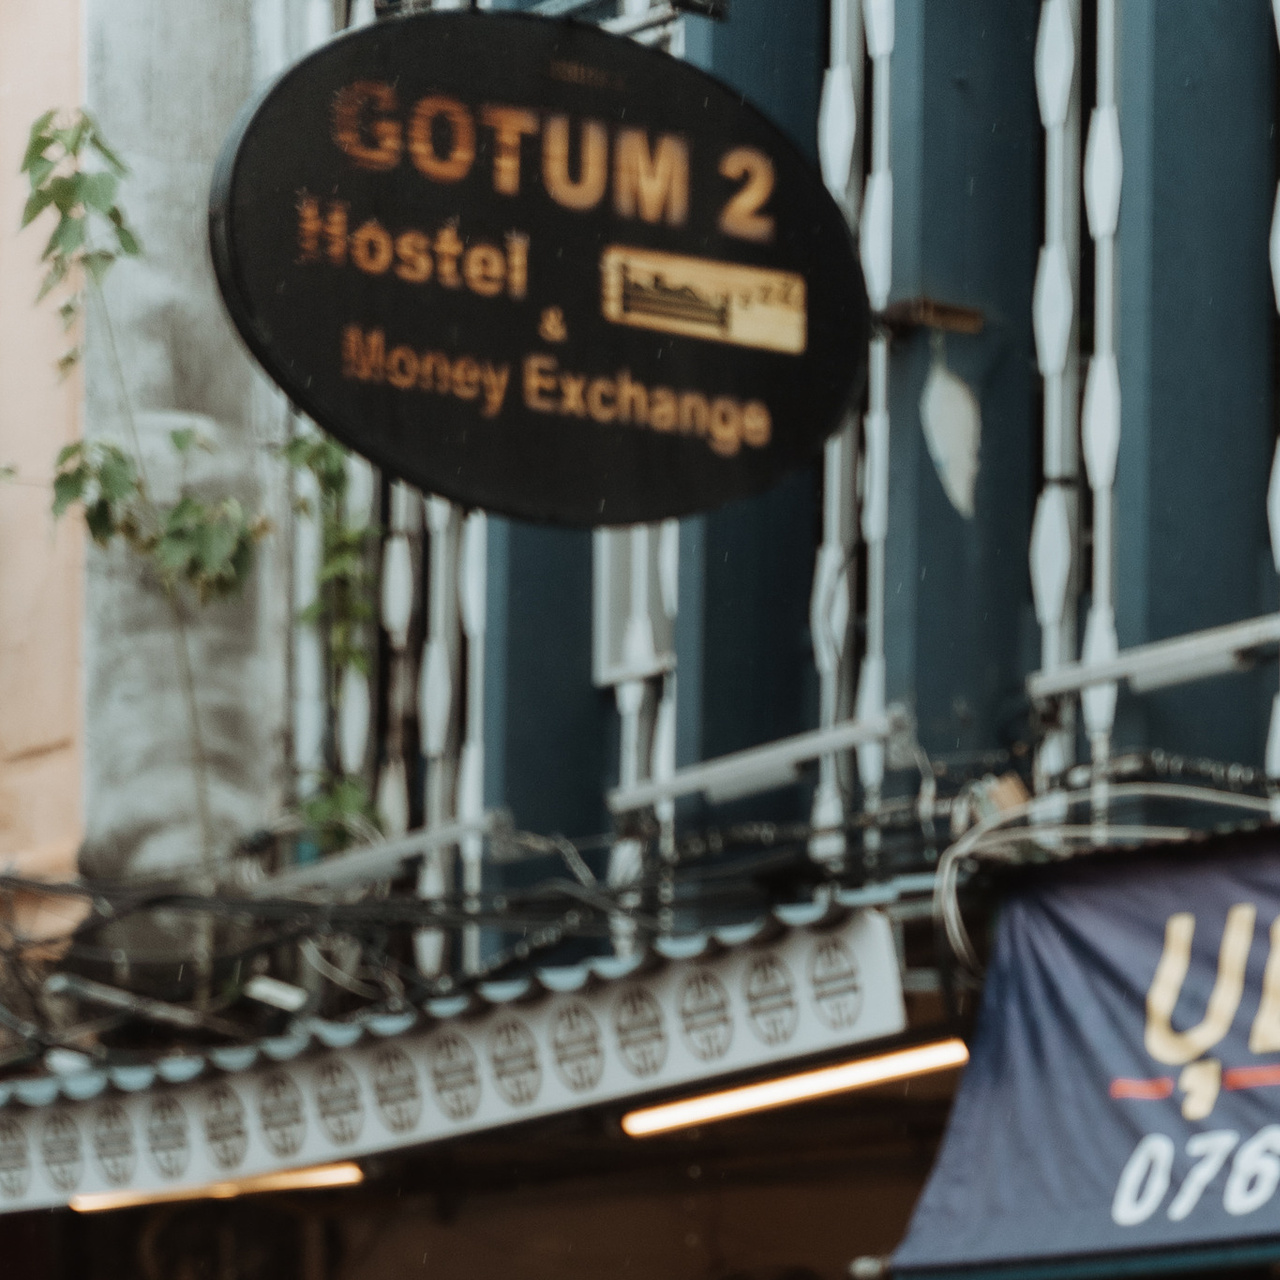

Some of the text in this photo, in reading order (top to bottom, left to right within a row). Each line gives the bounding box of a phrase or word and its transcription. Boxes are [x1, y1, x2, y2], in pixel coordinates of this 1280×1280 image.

[330, 78, 777, 244] GOTUM 2
[297, 193, 530, 299] Hostel
[538, 306, 569, 344] &
[340, 325, 774, 457] Money Exchange
